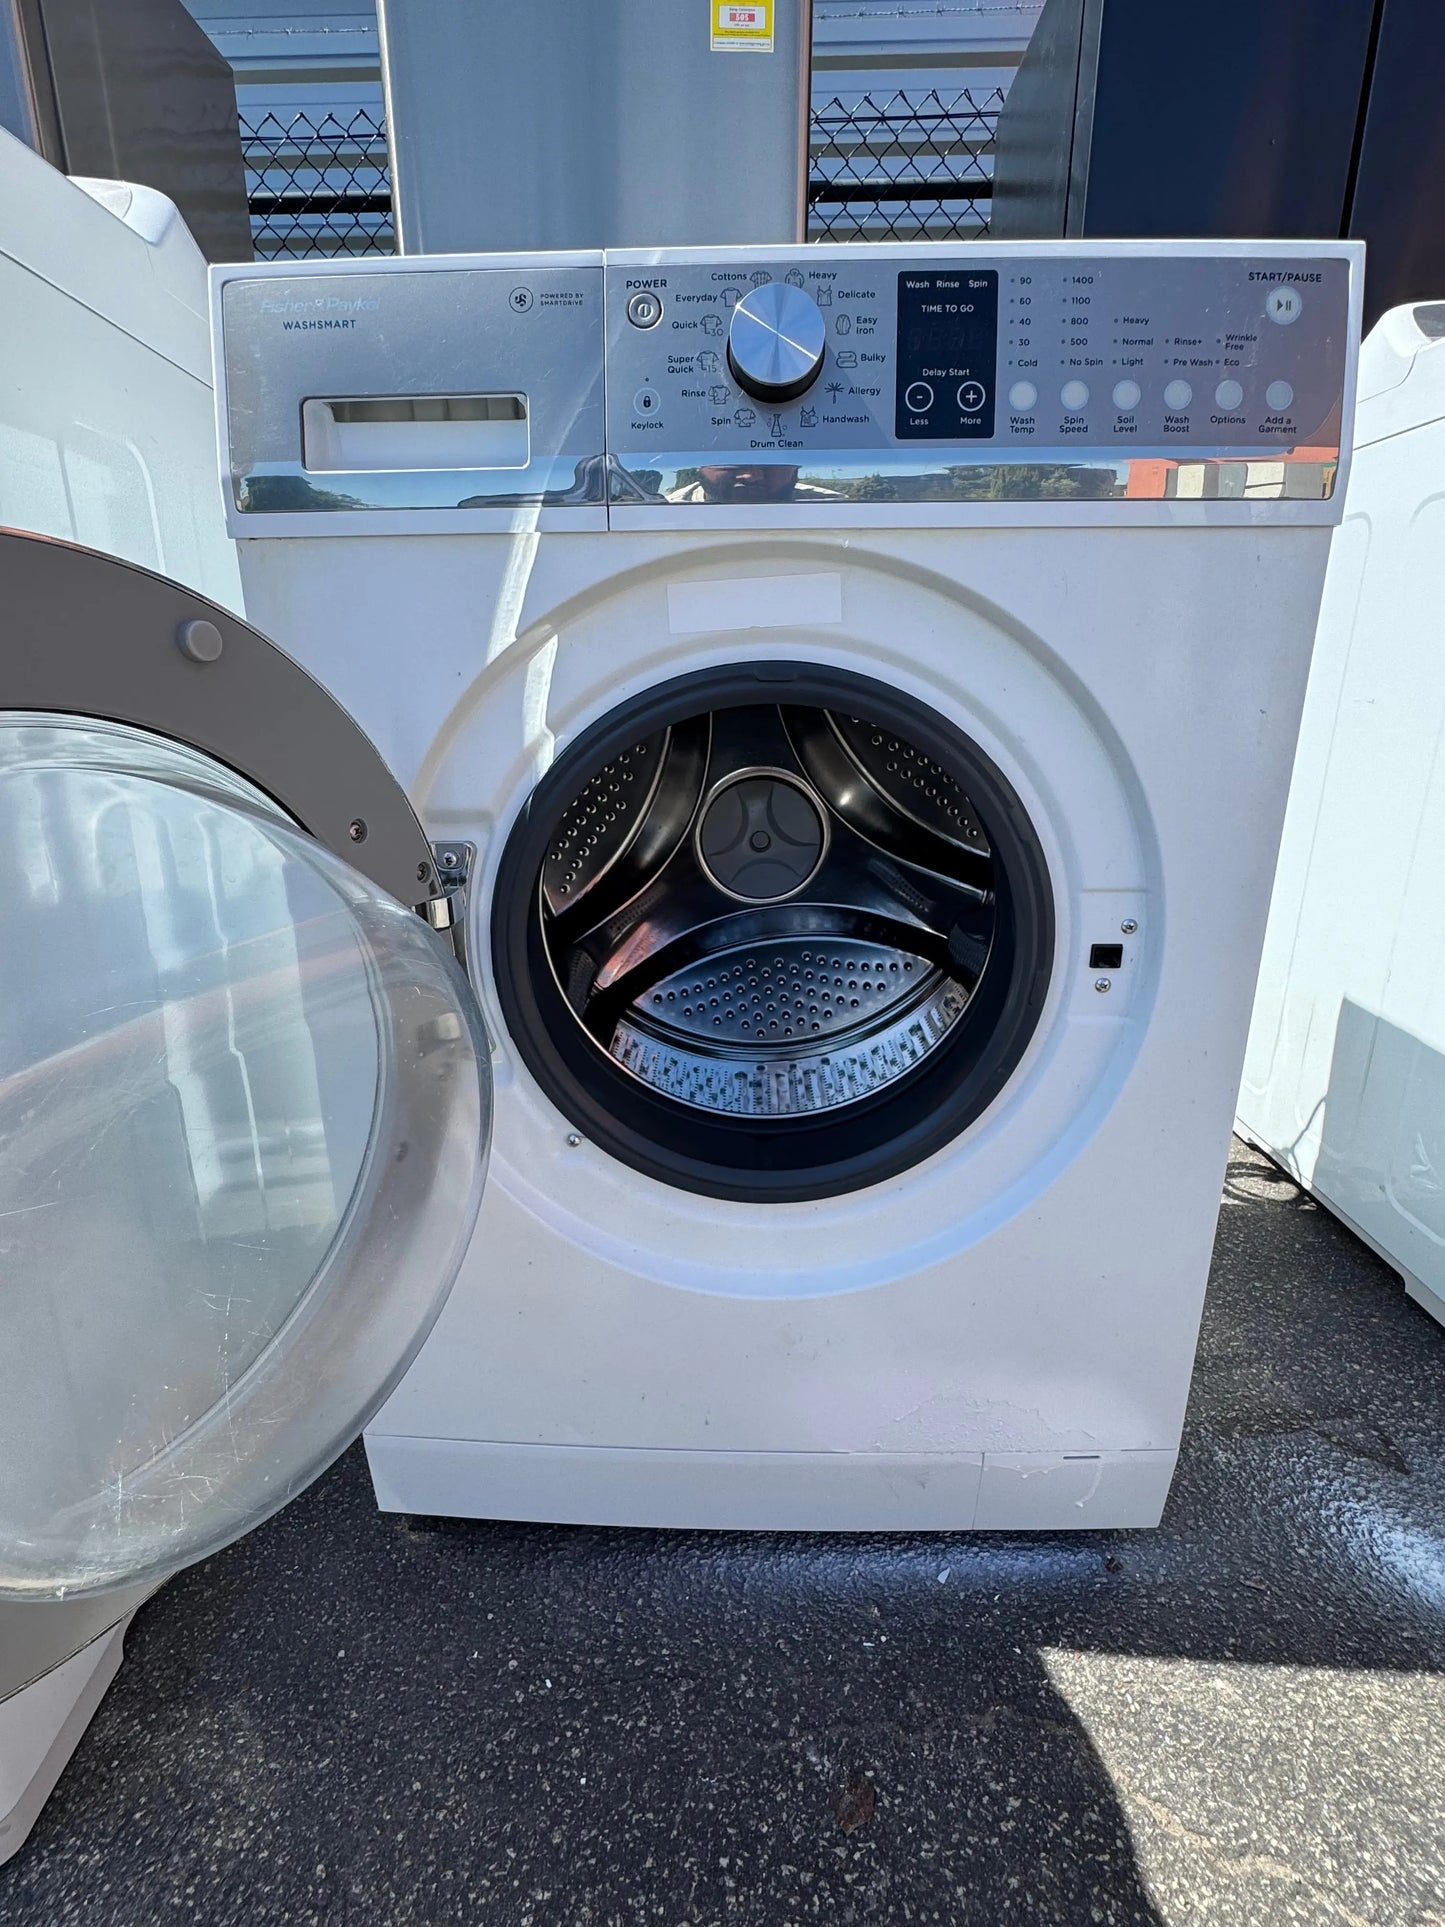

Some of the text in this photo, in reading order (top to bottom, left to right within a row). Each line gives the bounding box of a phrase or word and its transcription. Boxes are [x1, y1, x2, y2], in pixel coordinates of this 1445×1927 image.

[711, 272, 747, 281] Cottons
[809, 271, 837, 281] Heavy
[1248, 272, 1322, 283] START/PAUSE
[626, 279, 668, 289] POWER
[906, 281, 930, 289] Wash
[968, 280, 988, 288] Spin
[676, 294, 718, 304] Everyday
[838, 290, 876, 299] Delicate
[283, 320, 356, 330] WASHSMART
[856, 316, 878, 325] Easy
[1123, 317, 1150, 326] Heavy
[672, 321, 698, 330] Quick
[856, 326, 874, 334] Iron
[1226, 334, 1258, 342] Wrinkle
[668, 356, 694, 364] Super
[860, 354, 886, 362] Bulky
[1084, 358, 1104, 366] Spin
[1122, 358, 1144, 366] Light
[1173, 358, 1213, 366] Pre Wash
[668, 366, 694, 374] Quick
[922, 368, 970, 377] Delay Start
[682, 389, 706, 398] Rinse
[848, 386, 881, 396] Allergy
[711, 417, 731, 426] Spin
[822, 414, 870, 424] Handwash
[1010, 416, 1035, 424] Wash
[1064, 416, 1084, 425] Spin
[1117, 416, 1134, 424] Soil
[1164, 416, 1190, 424] Wash
[1210, 416, 1246, 425] Options
[1265, 416, 1284, 424] Add
[632, 421, 664, 430] Keylock
[1010, 426, 1035, 434] Temp
[1060, 424, 1088, 433] Speed
[1114, 424, 1138, 432] Level
[1164, 424, 1190, 433] Boost
[1258, 425, 1296, 434] Garment
[750, 439, 804, 448] Drum Clean
